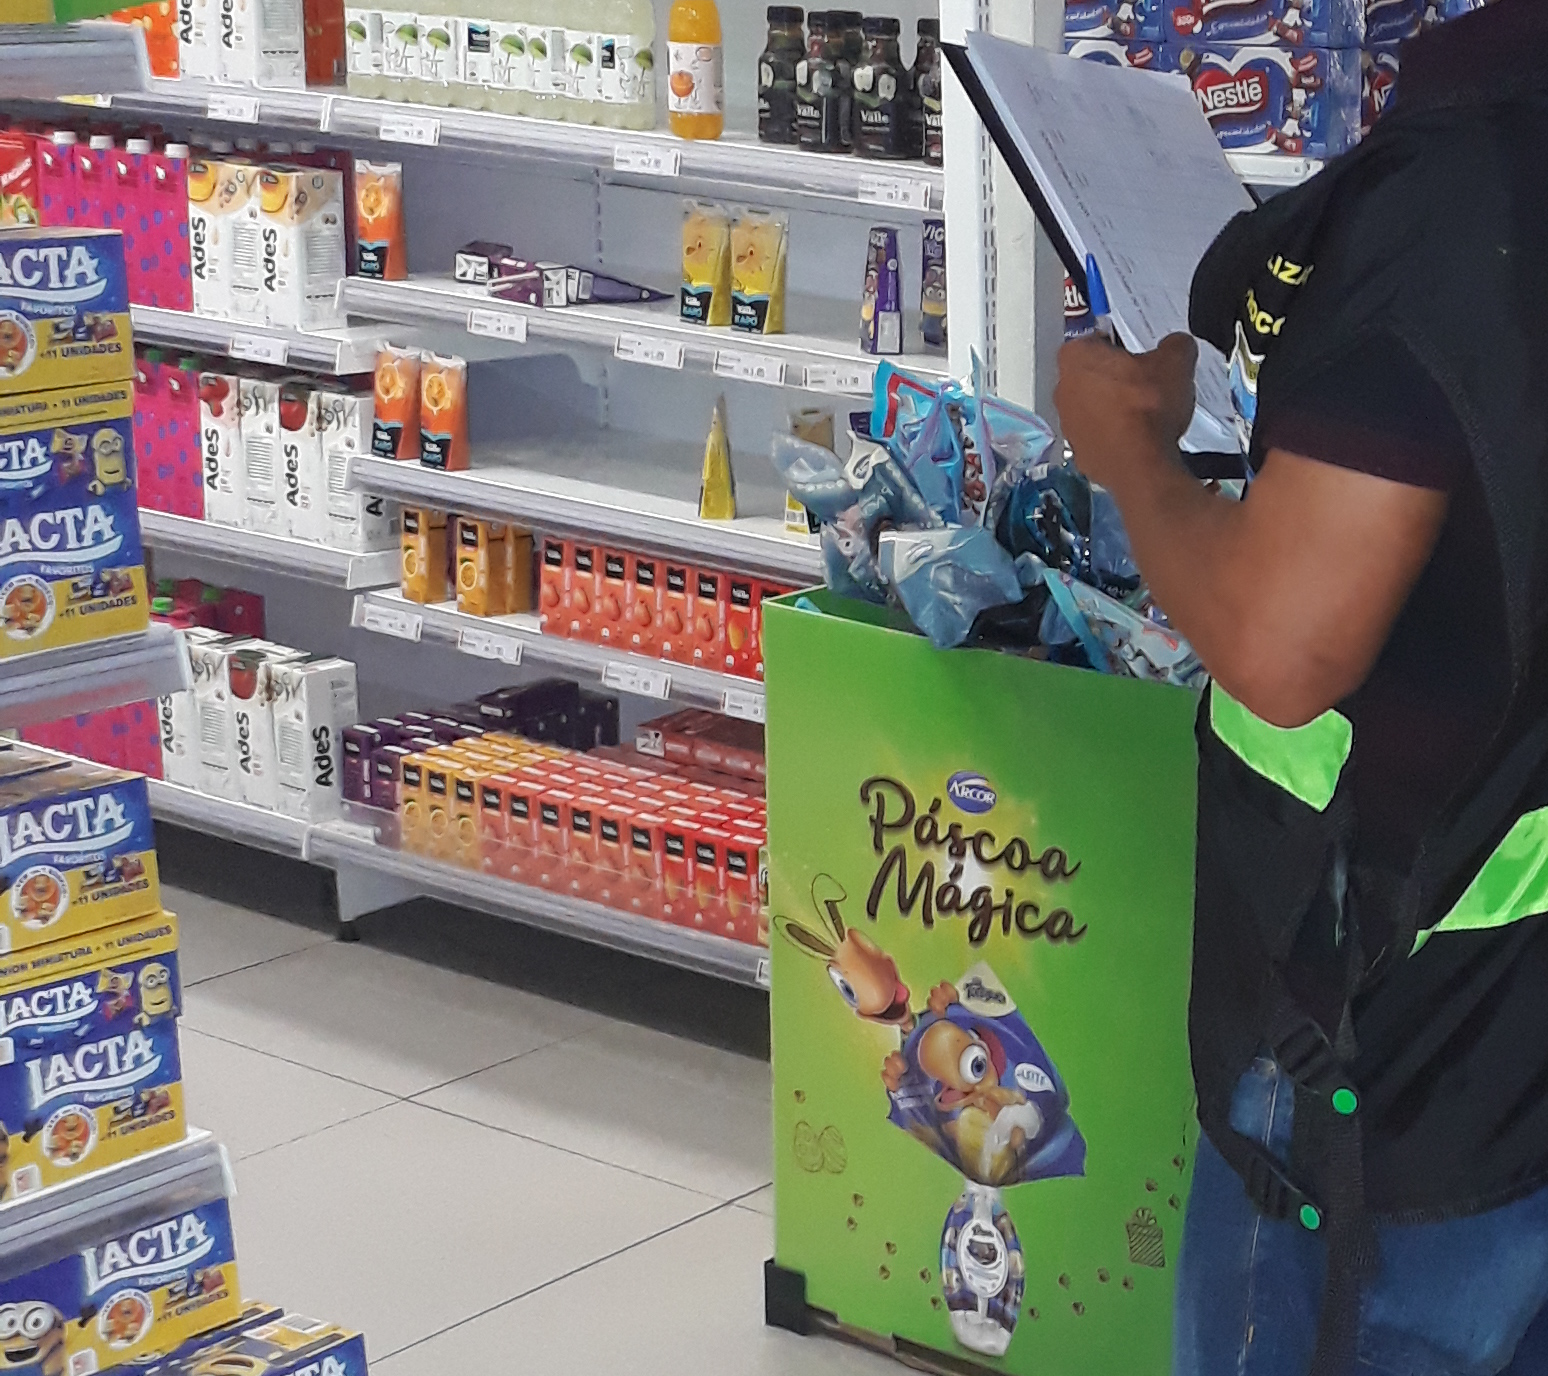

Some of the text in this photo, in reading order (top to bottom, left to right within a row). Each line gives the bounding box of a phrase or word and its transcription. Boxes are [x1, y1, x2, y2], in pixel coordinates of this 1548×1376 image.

[191, 215, 207, 281] AdeS
[262, 227, 278, 292] AdeS
[204, 427, 220, 491] AdeS
[283, 443, 299, 507] AdeS
[235, 710, 251, 774] AdeS
[312, 724, 334, 788] AdeS
[948, 779, 997, 805] ARCOR
[860, 776, 1082, 883] Páscoa
[866, 842, 1089, 945] Mágica
[24, 1028, 156, 1111] LACTA
[80, 1211, 209, 1298] LACTA
